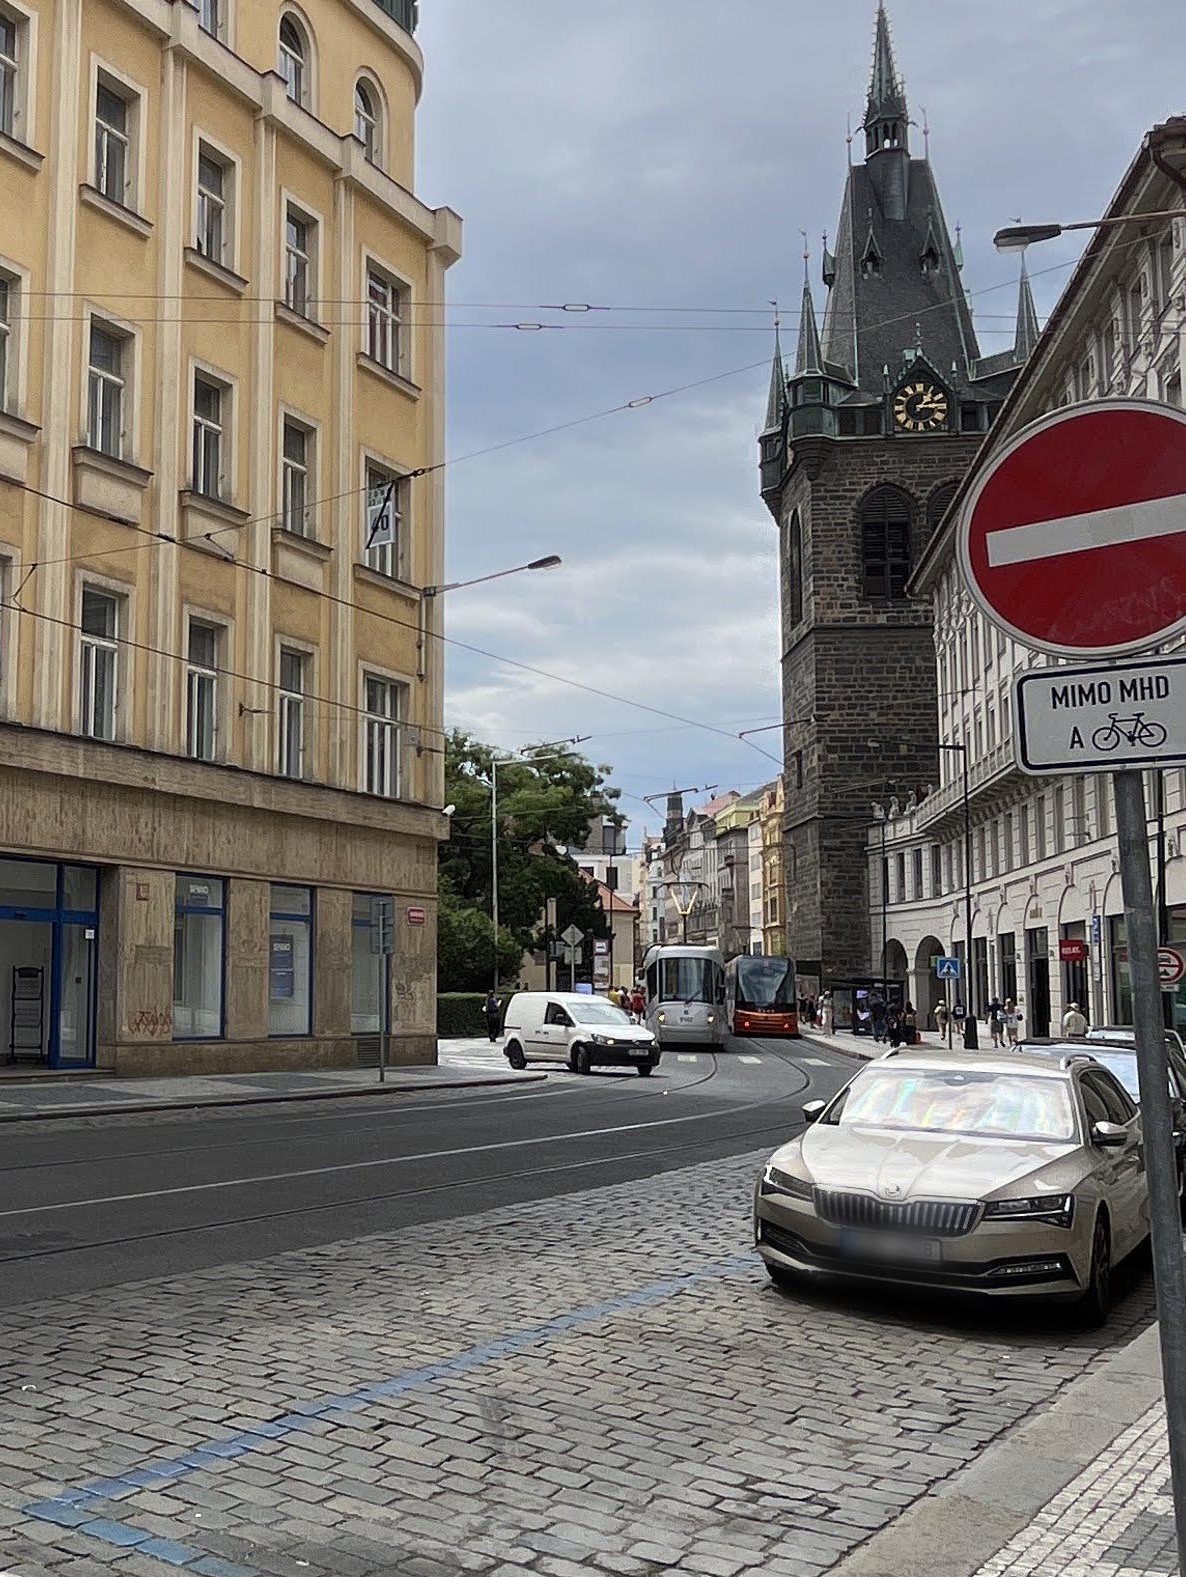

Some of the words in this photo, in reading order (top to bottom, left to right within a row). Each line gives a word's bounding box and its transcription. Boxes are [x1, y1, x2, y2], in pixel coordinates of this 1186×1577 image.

[1051, 681, 1111, 710] MIMO
[1119, 675, 1169, 703] MHD
[1069, 726, 1085, 750] A
